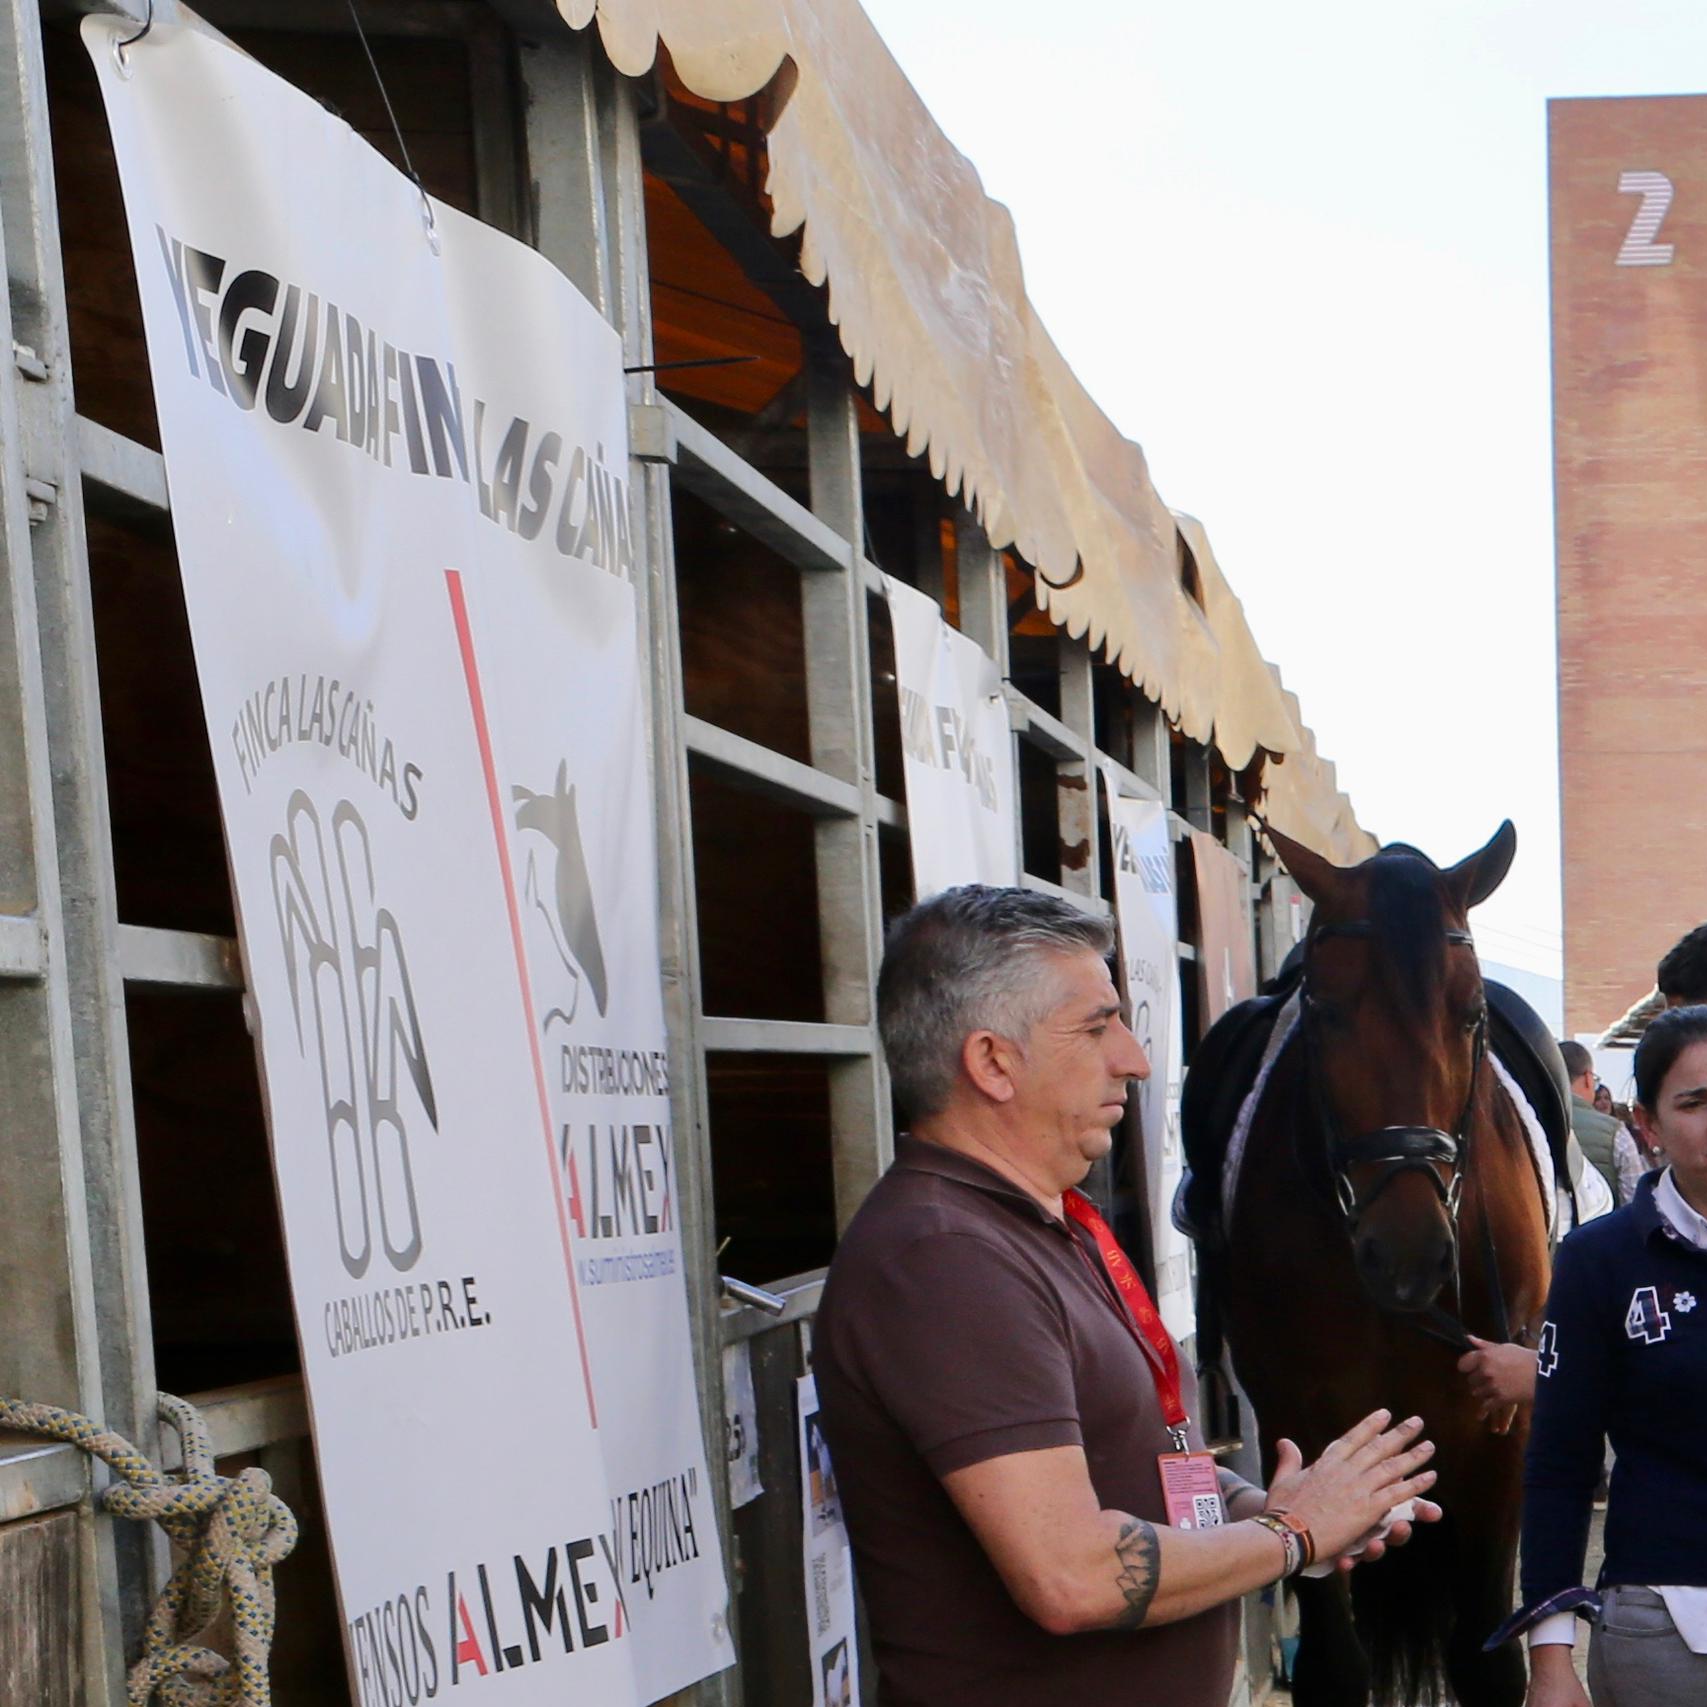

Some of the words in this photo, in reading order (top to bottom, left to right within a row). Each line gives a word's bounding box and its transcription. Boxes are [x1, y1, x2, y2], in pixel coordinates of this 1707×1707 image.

[1615, 170, 1674, 266] 2
[155, 223, 379, 462] YEGUADA
[473, 399, 563, 541] LAS
[556, 441, 635, 579] CAÑA
[231, 676, 292, 796] FINCA
[297, 673, 340, 747] LAS
[338, 690, 423, 822] CAÑAS
[561, 1123, 674, 1239] ALMEX
[324, 1289, 396, 1358] CABALLOS
[394, 1285, 420, 1340] DE
[419, 1276, 492, 1335] P.R.E.
[1624, 1286, 1672, 1345] 4
[448, 1532, 631, 1686] ALMEX
